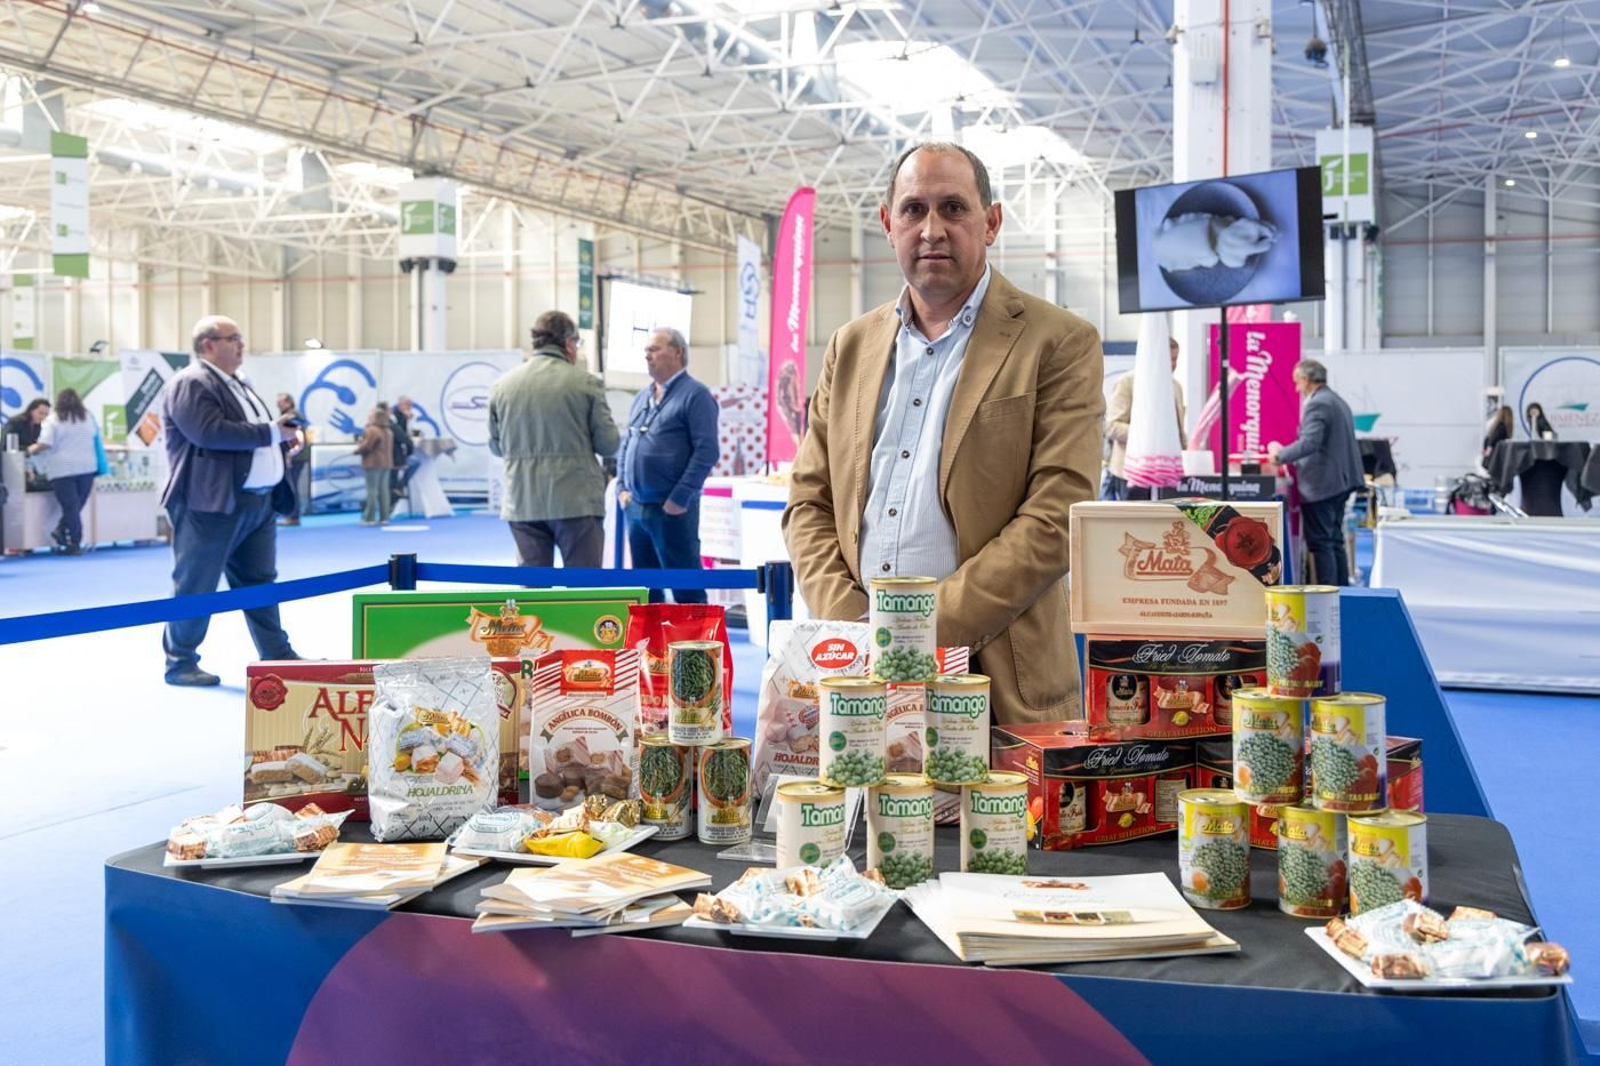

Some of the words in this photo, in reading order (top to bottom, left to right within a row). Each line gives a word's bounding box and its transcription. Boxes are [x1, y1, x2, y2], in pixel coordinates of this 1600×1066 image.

[1246, 331, 1266, 351] la
[1240, 350, 1272, 458] Menorqui
[1188, 477, 1260, 496] Menoquina
[1138, 550, 1193, 573] Mata
[1122, 597, 1159, 605] EMPRESA
[1160, 598, 1197, 606] FUNDADA
[815, 650, 854, 662] AZÚCAR
[827, 643, 845, 651] SIN
[1133, 643, 1177, 664] Fried
[1178, 643, 1231, 663] Tomato
[308, 687, 375, 721] ALF
[830, 692, 887, 719] Tamang
[886, 703, 917, 721] NGÉLICA
[926, 688, 986, 719] Tamango
[774, 753, 819, 765] HOJALDR
[1084, 747, 1123, 769] Fried
[1124, 744, 1170, 766] Tomato
[879, 793, 933, 819] Tamang
[970, 790, 1027, 817] Tamang
[1200, 819, 1235, 834] Mata
